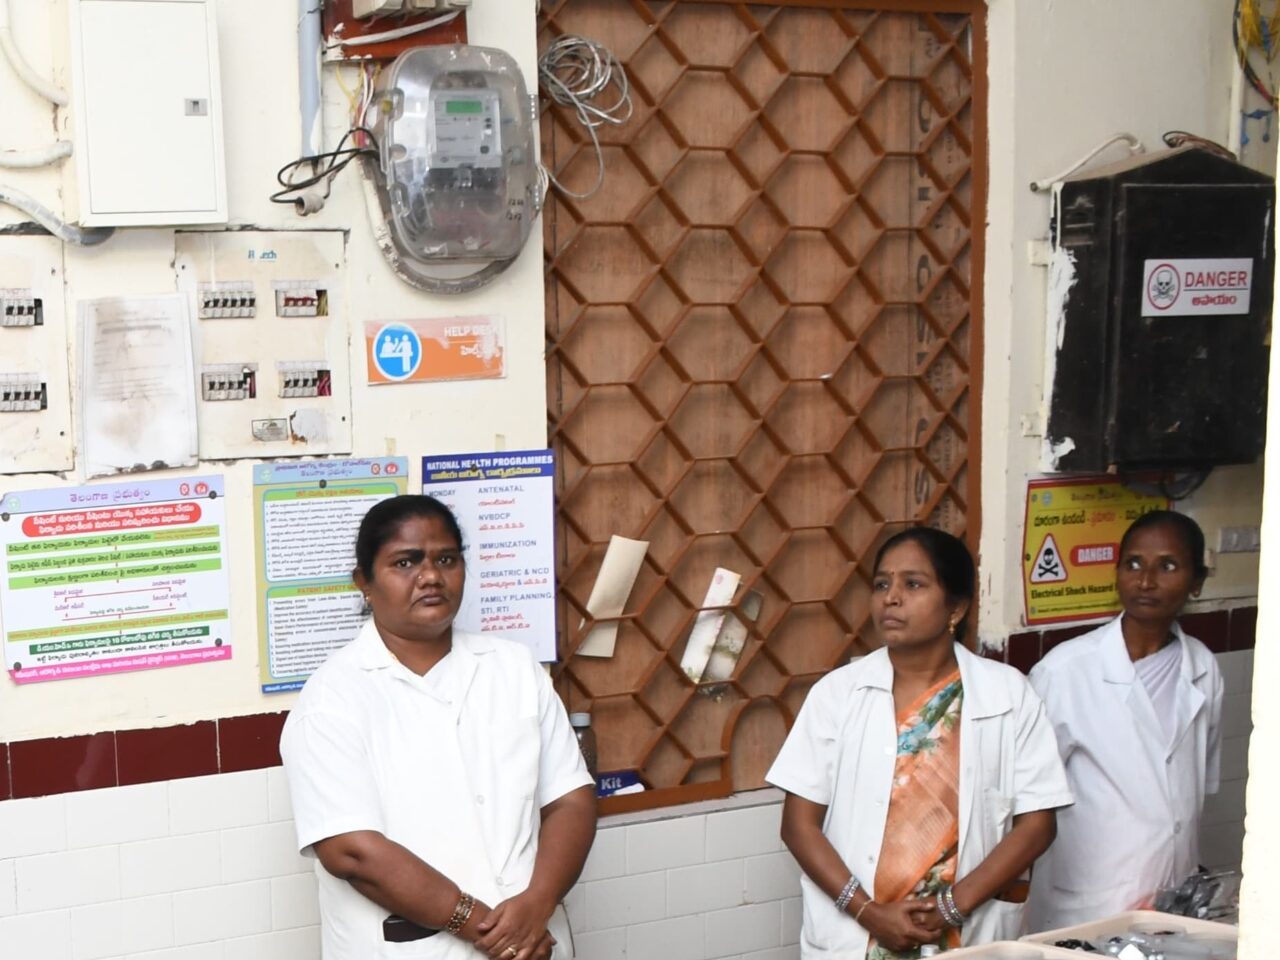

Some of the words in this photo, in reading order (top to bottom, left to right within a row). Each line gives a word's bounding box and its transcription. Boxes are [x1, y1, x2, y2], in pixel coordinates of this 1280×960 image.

[1185, 271, 1247, 287] DANGER
[1192, 294, 1237, 306] అపాయం
[427, 461, 460, 470] NATIONAL
[462, 458, 491, 468] HEALTH
[493, 455, 553, 467] PROGRAMMES
[478, 485, 524, 494] ANTENATAL
[70, 492, 109, 503] తెలంగాణ
[478, 513, 511, 521] NVBDCP
[480, 540, 537, 549] IMMUNIZATION
[1078, 546, 1114, 564] DANGER
[480, 569, 521, 578] GERIATRIC
[532, 567, 549, 575] NCD
[1031, 588, 1064, 599] Electrical
[1065, 586, 1087, 597] Shock
[1088, 584, 1113, 594] Hazard
[480, 595, 507, 603] FAMILY
[601, 776, 623, 790] Kit
